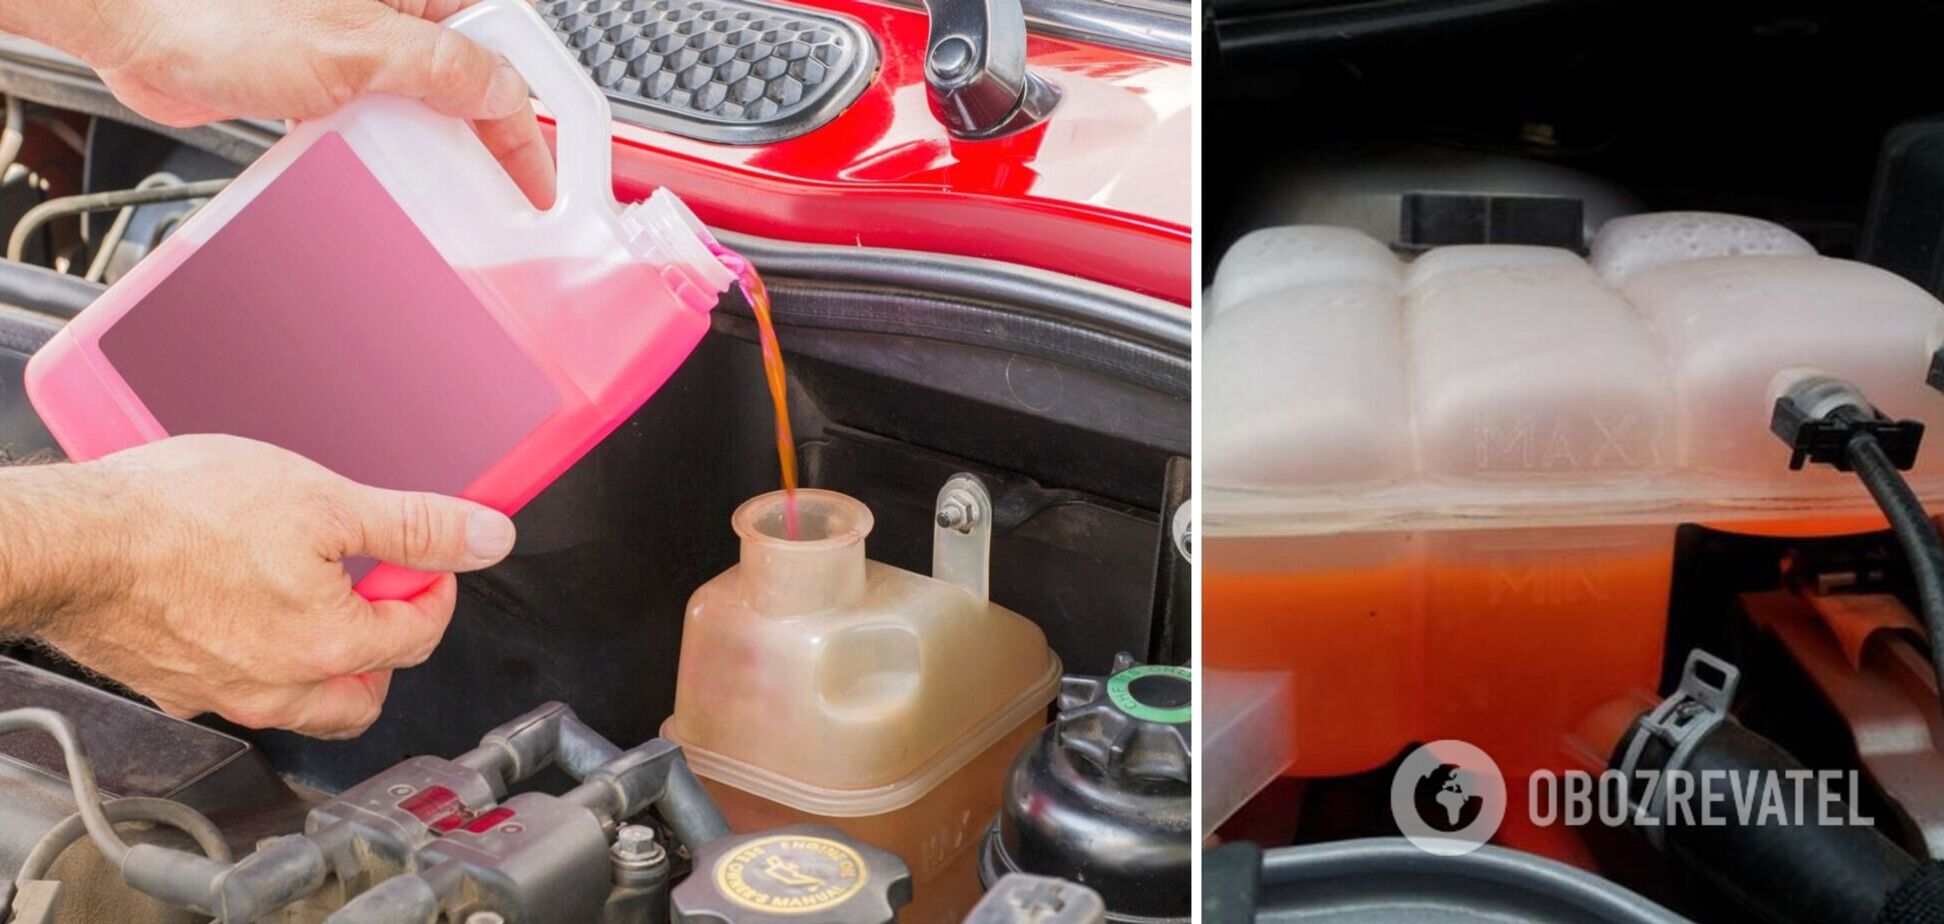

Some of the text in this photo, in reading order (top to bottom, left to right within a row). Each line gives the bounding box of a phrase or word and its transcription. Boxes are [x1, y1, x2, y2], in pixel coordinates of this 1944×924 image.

[737, 847, 765, 863] SEE
[771, 886, 847, 907] MANUAL
[781, 842, 857, 878] ENGINE OIL
